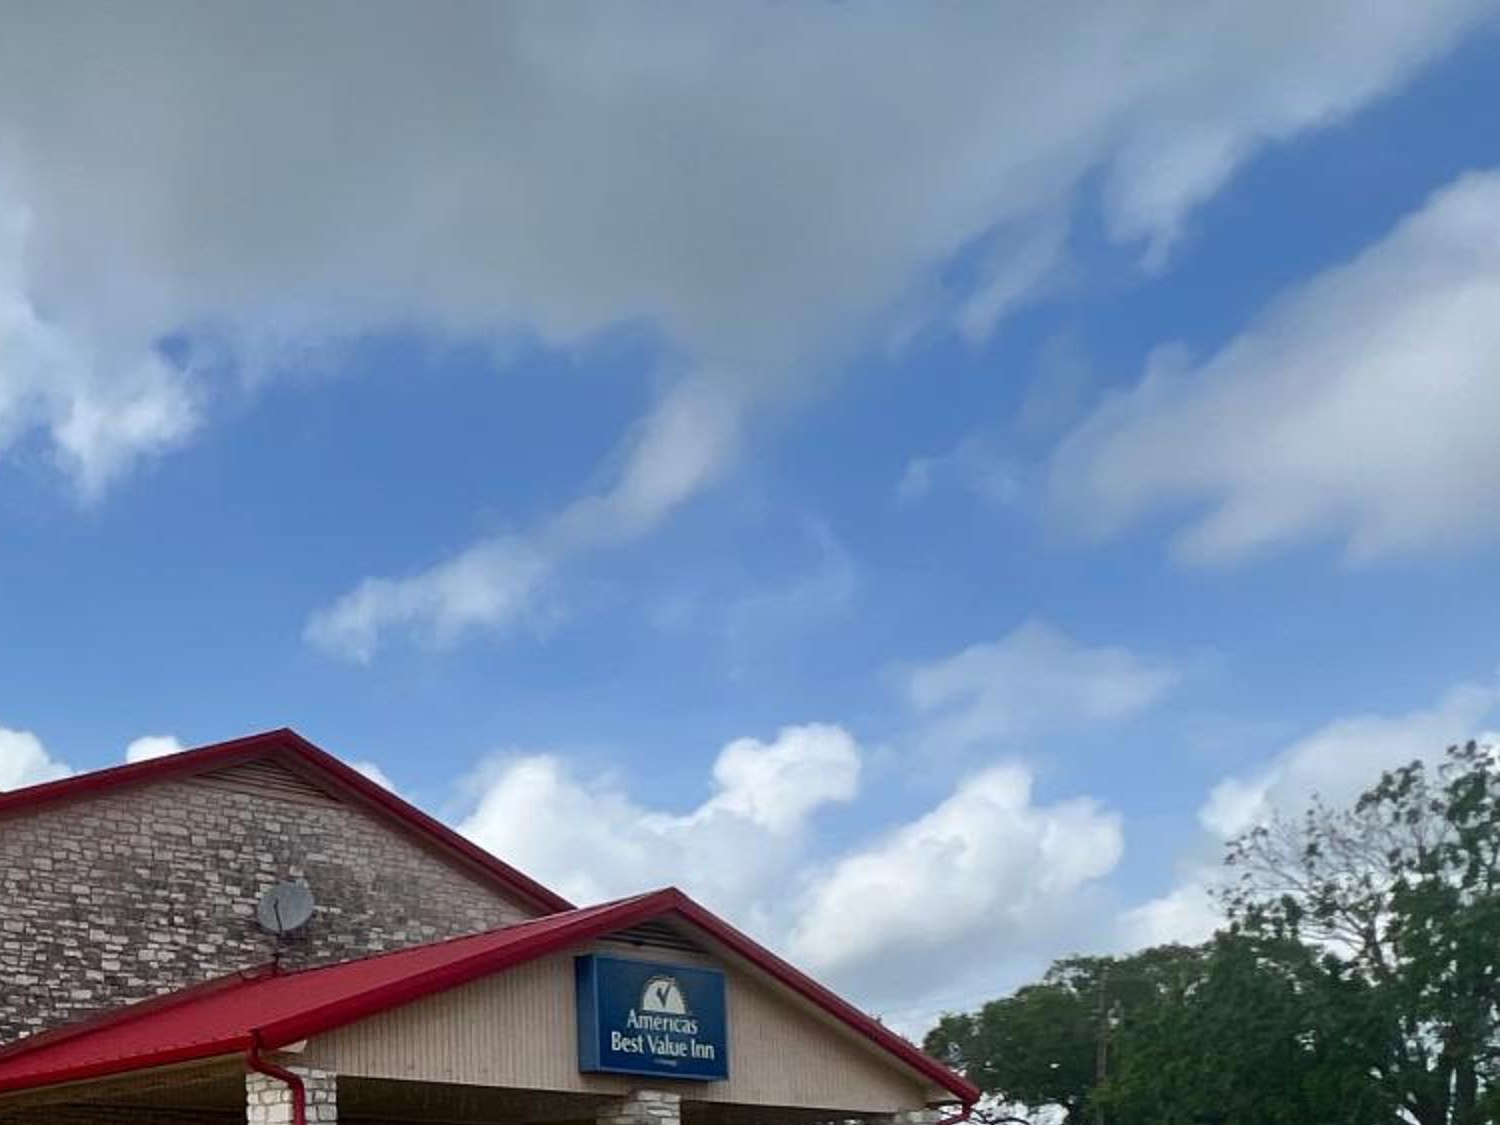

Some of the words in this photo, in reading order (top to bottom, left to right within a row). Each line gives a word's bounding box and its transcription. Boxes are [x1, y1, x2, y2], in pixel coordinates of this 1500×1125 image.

[627, 1008, 699, 1035] Americas
[611, 1031, 644, 1053] Best
[648, 1034, 688, 1057] Value
[691, 1039, 715, 1060] Inn
